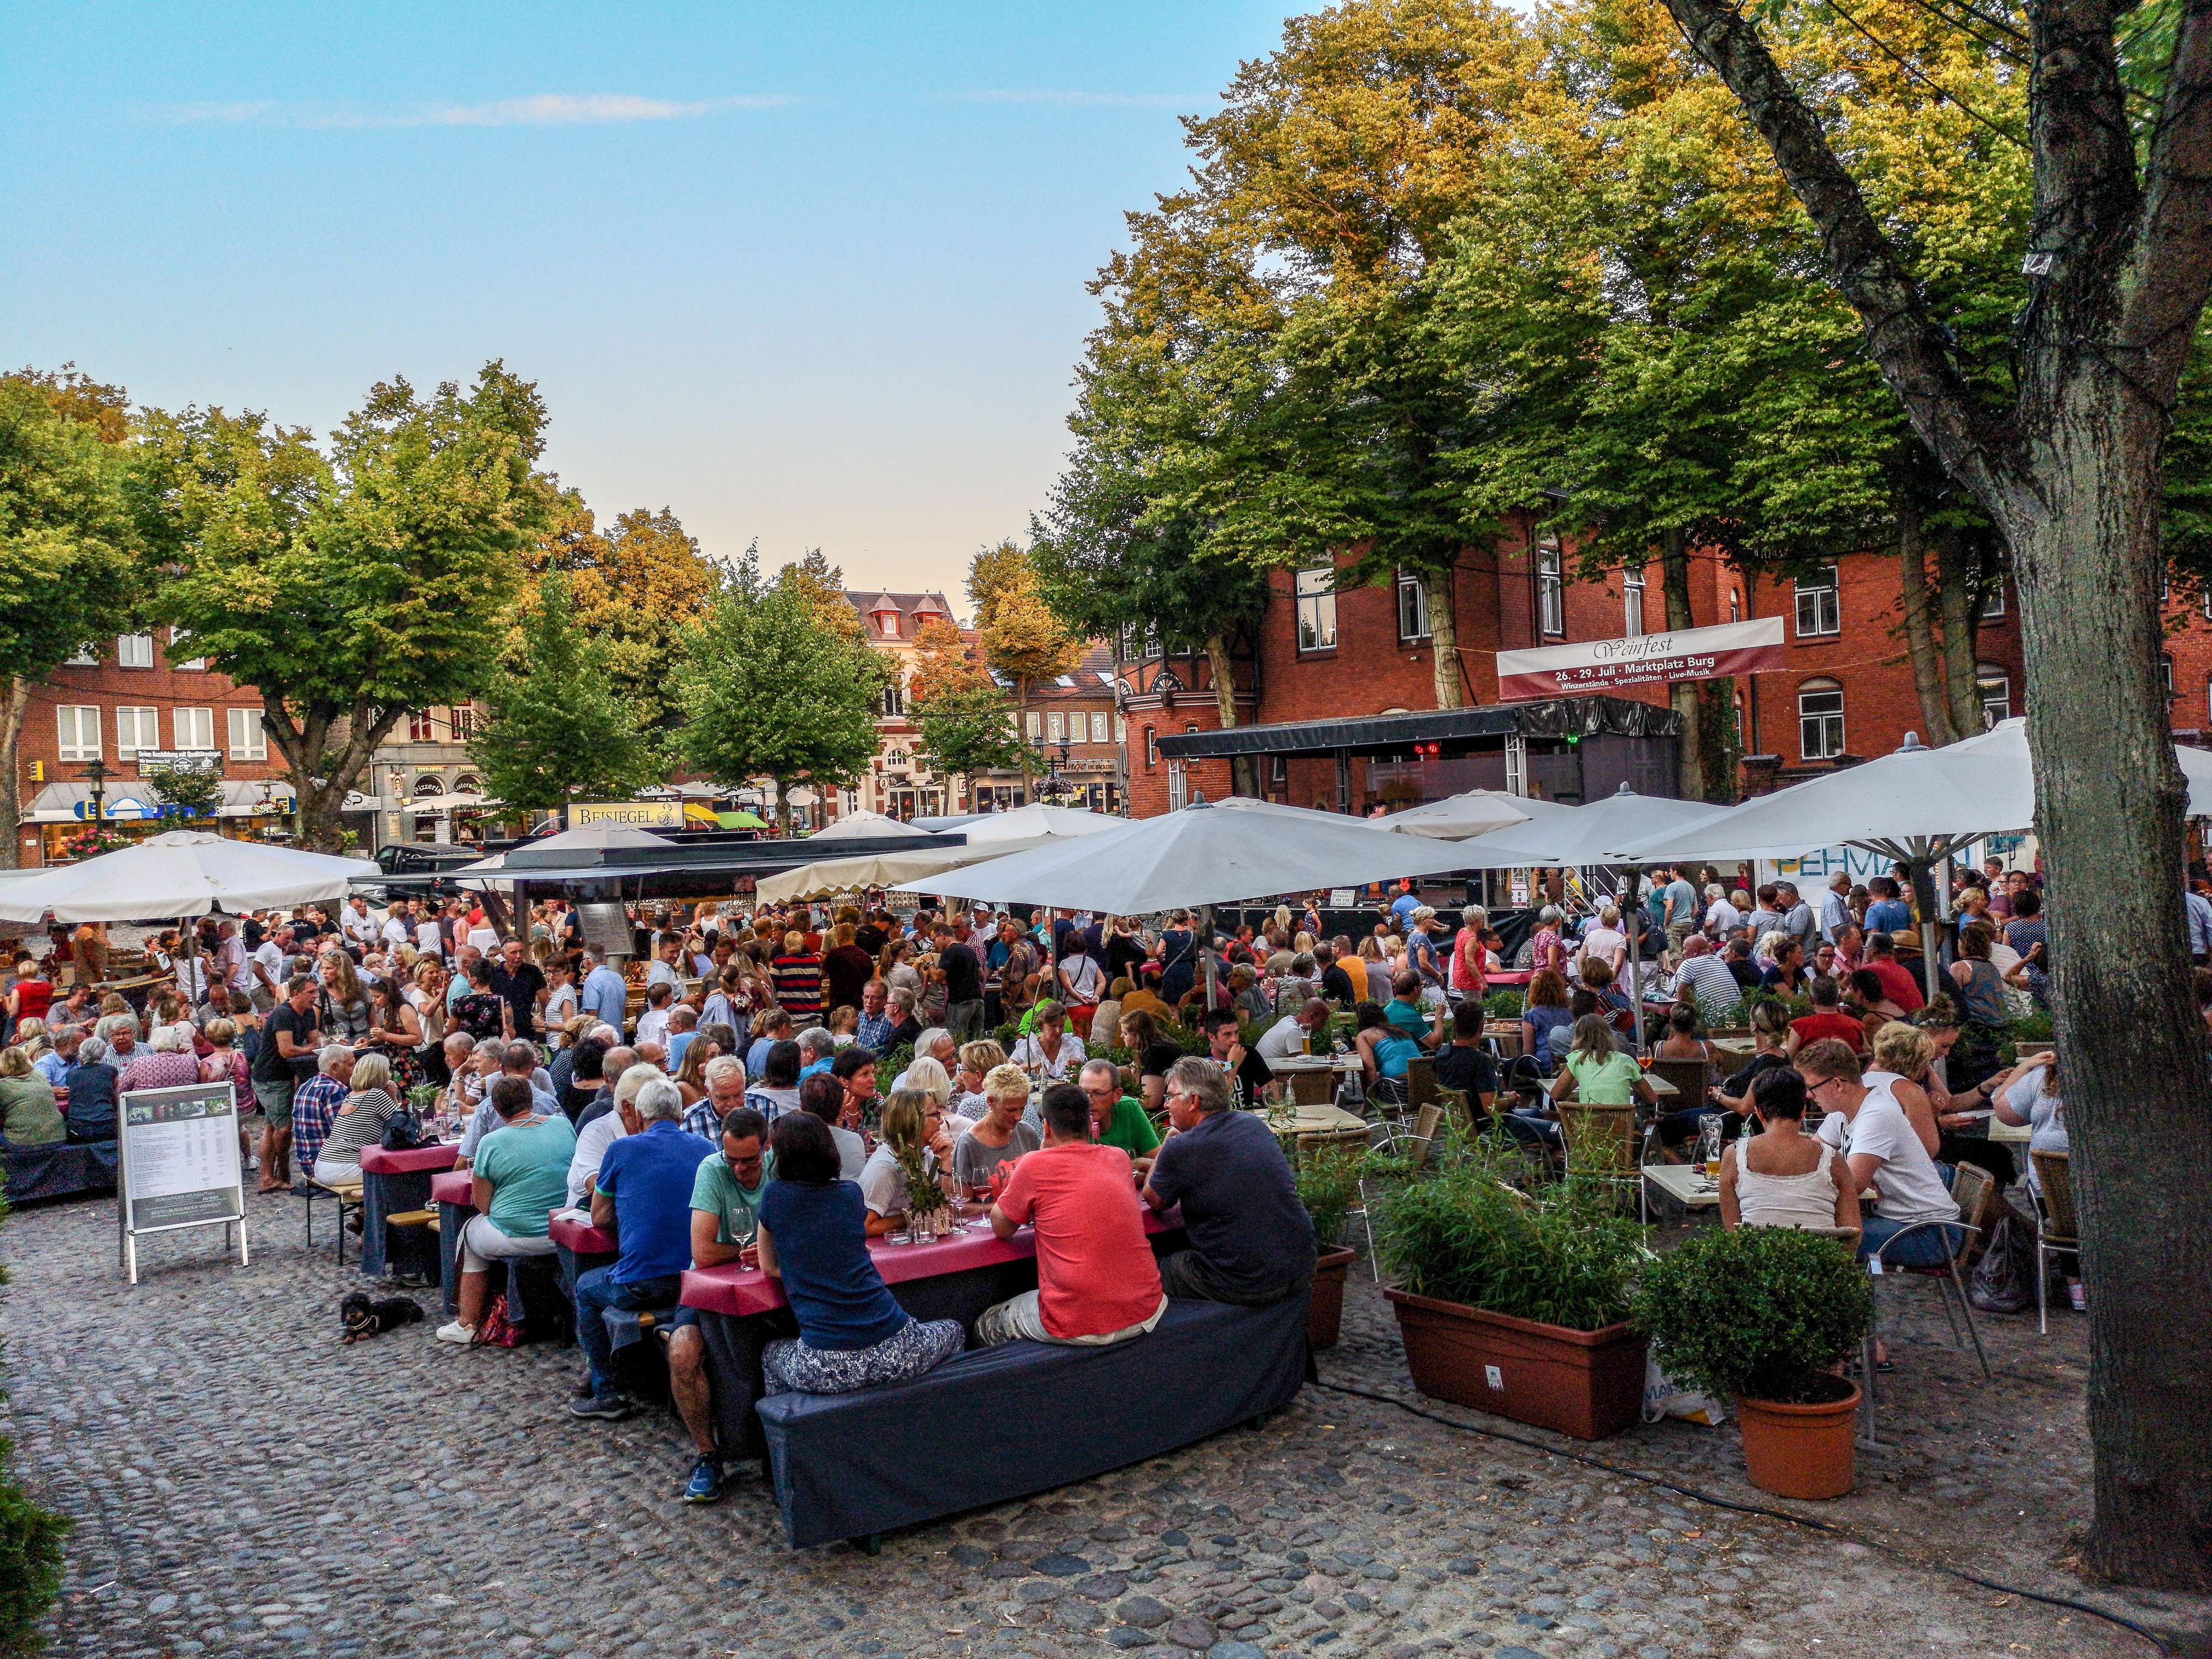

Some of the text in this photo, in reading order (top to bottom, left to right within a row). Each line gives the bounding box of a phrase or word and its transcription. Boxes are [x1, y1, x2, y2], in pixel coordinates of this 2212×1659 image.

[1594, 635, 1673, 660] Weinfest
[1555, 671, 1572, 682] 26.
[1579, 669, 1595, 680] 29.
[1598, 667, 1615, 677] Juli
[1625, 658, 1684, 674] Marktplatz
[1687, 656, 1715, 667] Burg
[1561, 668, 1710, 690] Winzerstände Spezialitäten Live-Musik
[414, 784, 442, 795] Pizzeria
[1777, 847, 1970, 877] FEHMN
